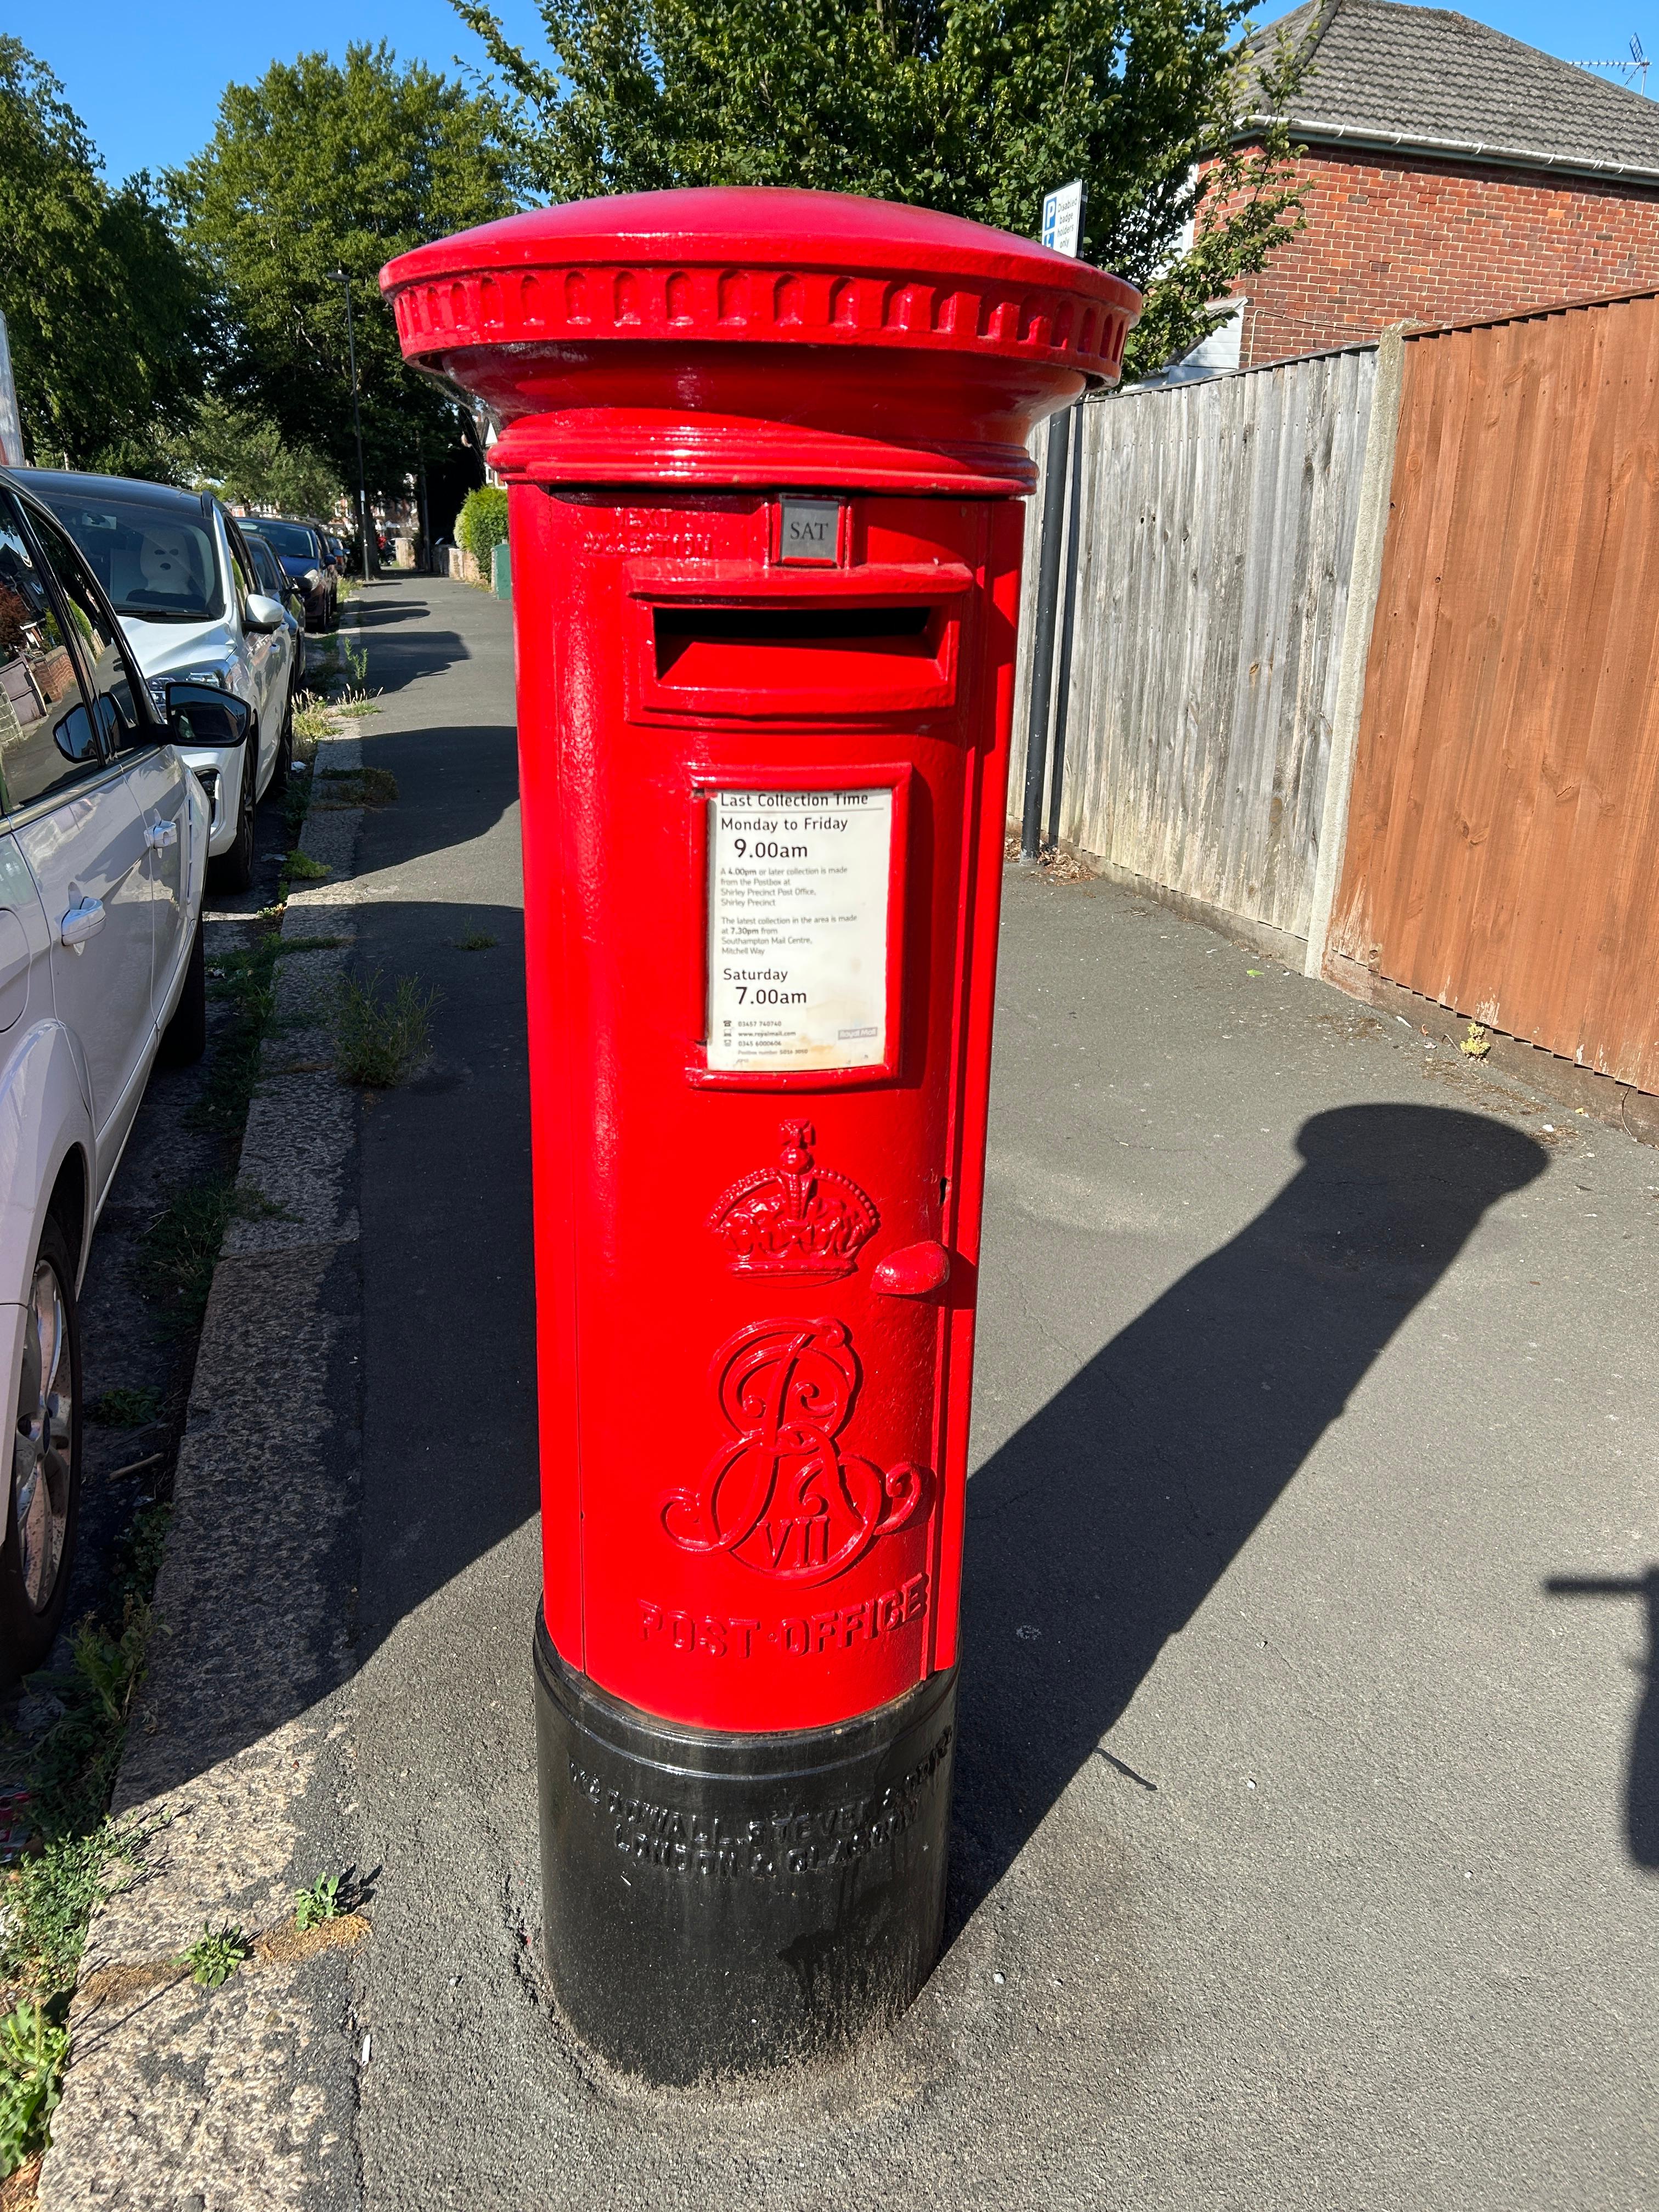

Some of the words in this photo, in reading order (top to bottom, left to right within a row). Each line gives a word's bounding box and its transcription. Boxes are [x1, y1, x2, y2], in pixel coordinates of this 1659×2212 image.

[1058, 196, 1077, 213] Disabled
[1059, 212, 1074, 224] badge
[1057, 224, 1074, 238] holders
[1059, 237, 1070, 249] only
[789, 521, 828, 541] SAT
[721, 793, 753, 806] Last
[758, 793, 828, 806] Collection
[833, 792, 868, 806] Time
[721, 817, 778, 833] Monday
[785, 819, 798, 830] to
[804, 817, 848, 832] Friday
[734, 838, 808, 858] 9.00am
[729, 868, 757, 876] 4.00pm
[754, 878, 781, 886] Postbox
[721, 888, 745, 897] Shirley
[721, 898, 745, 907] Shirley
[747, 898, 776, 906] Precinct
[731, 927, 759, 935] 7.30pm
[721, 936, 769, 946] Southampton
[750, 947, 765, 956] Way
[724, 968, 788, 983] Saturday
[735, 986, 807, 1005] 7.00am
[637, 1598, 761, 1659] POST
[780, 1572, 928, 1658] OFFICE
